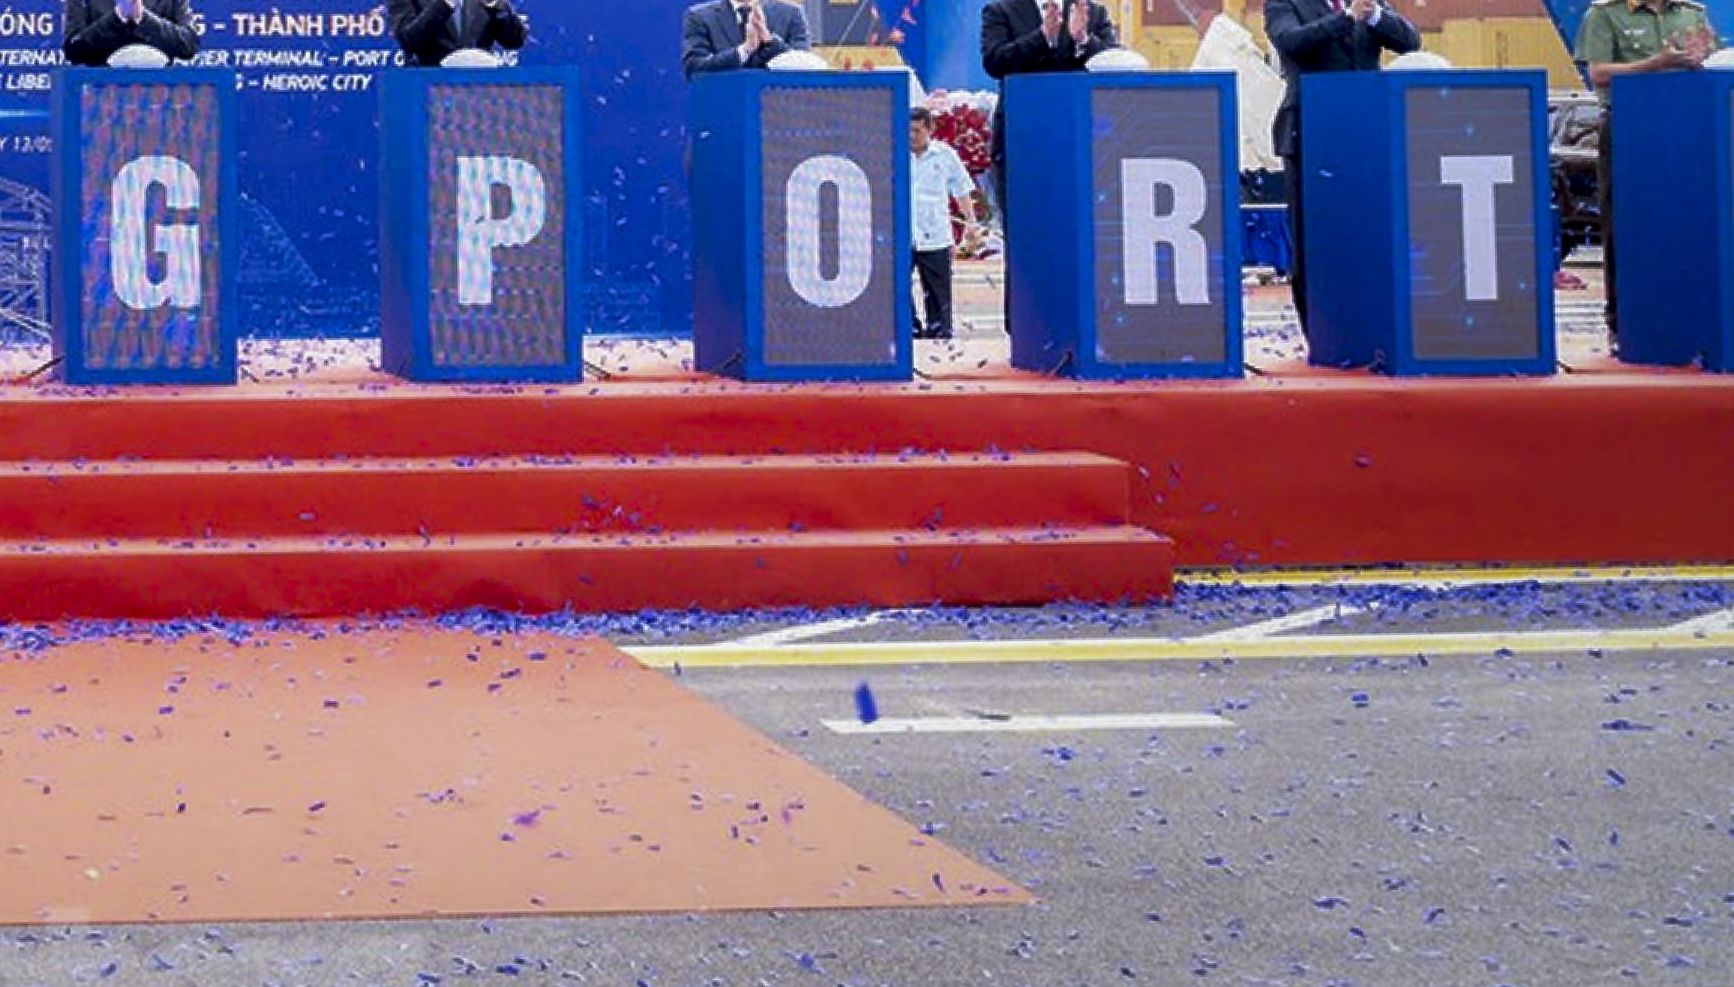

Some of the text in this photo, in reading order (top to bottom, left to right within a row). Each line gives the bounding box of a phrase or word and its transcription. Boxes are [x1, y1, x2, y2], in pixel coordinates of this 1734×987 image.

[232, 7, 324, 36] THÀNH
[330, 5, 386, 36] PHỐ
[234, 50, 324, 67] TERMINAL
[343, 50, 391, 67] PORT
[262, 73, 328, 91] HEROIC
[332, 73, 373, 91] CITY
[110, 156, 201, 309] G
[456, 156, 546, 305] P
[787, 155, 873, 308] O
[1121, 157, 1210, 306] R
[1440, 154, 1515, 301] T
